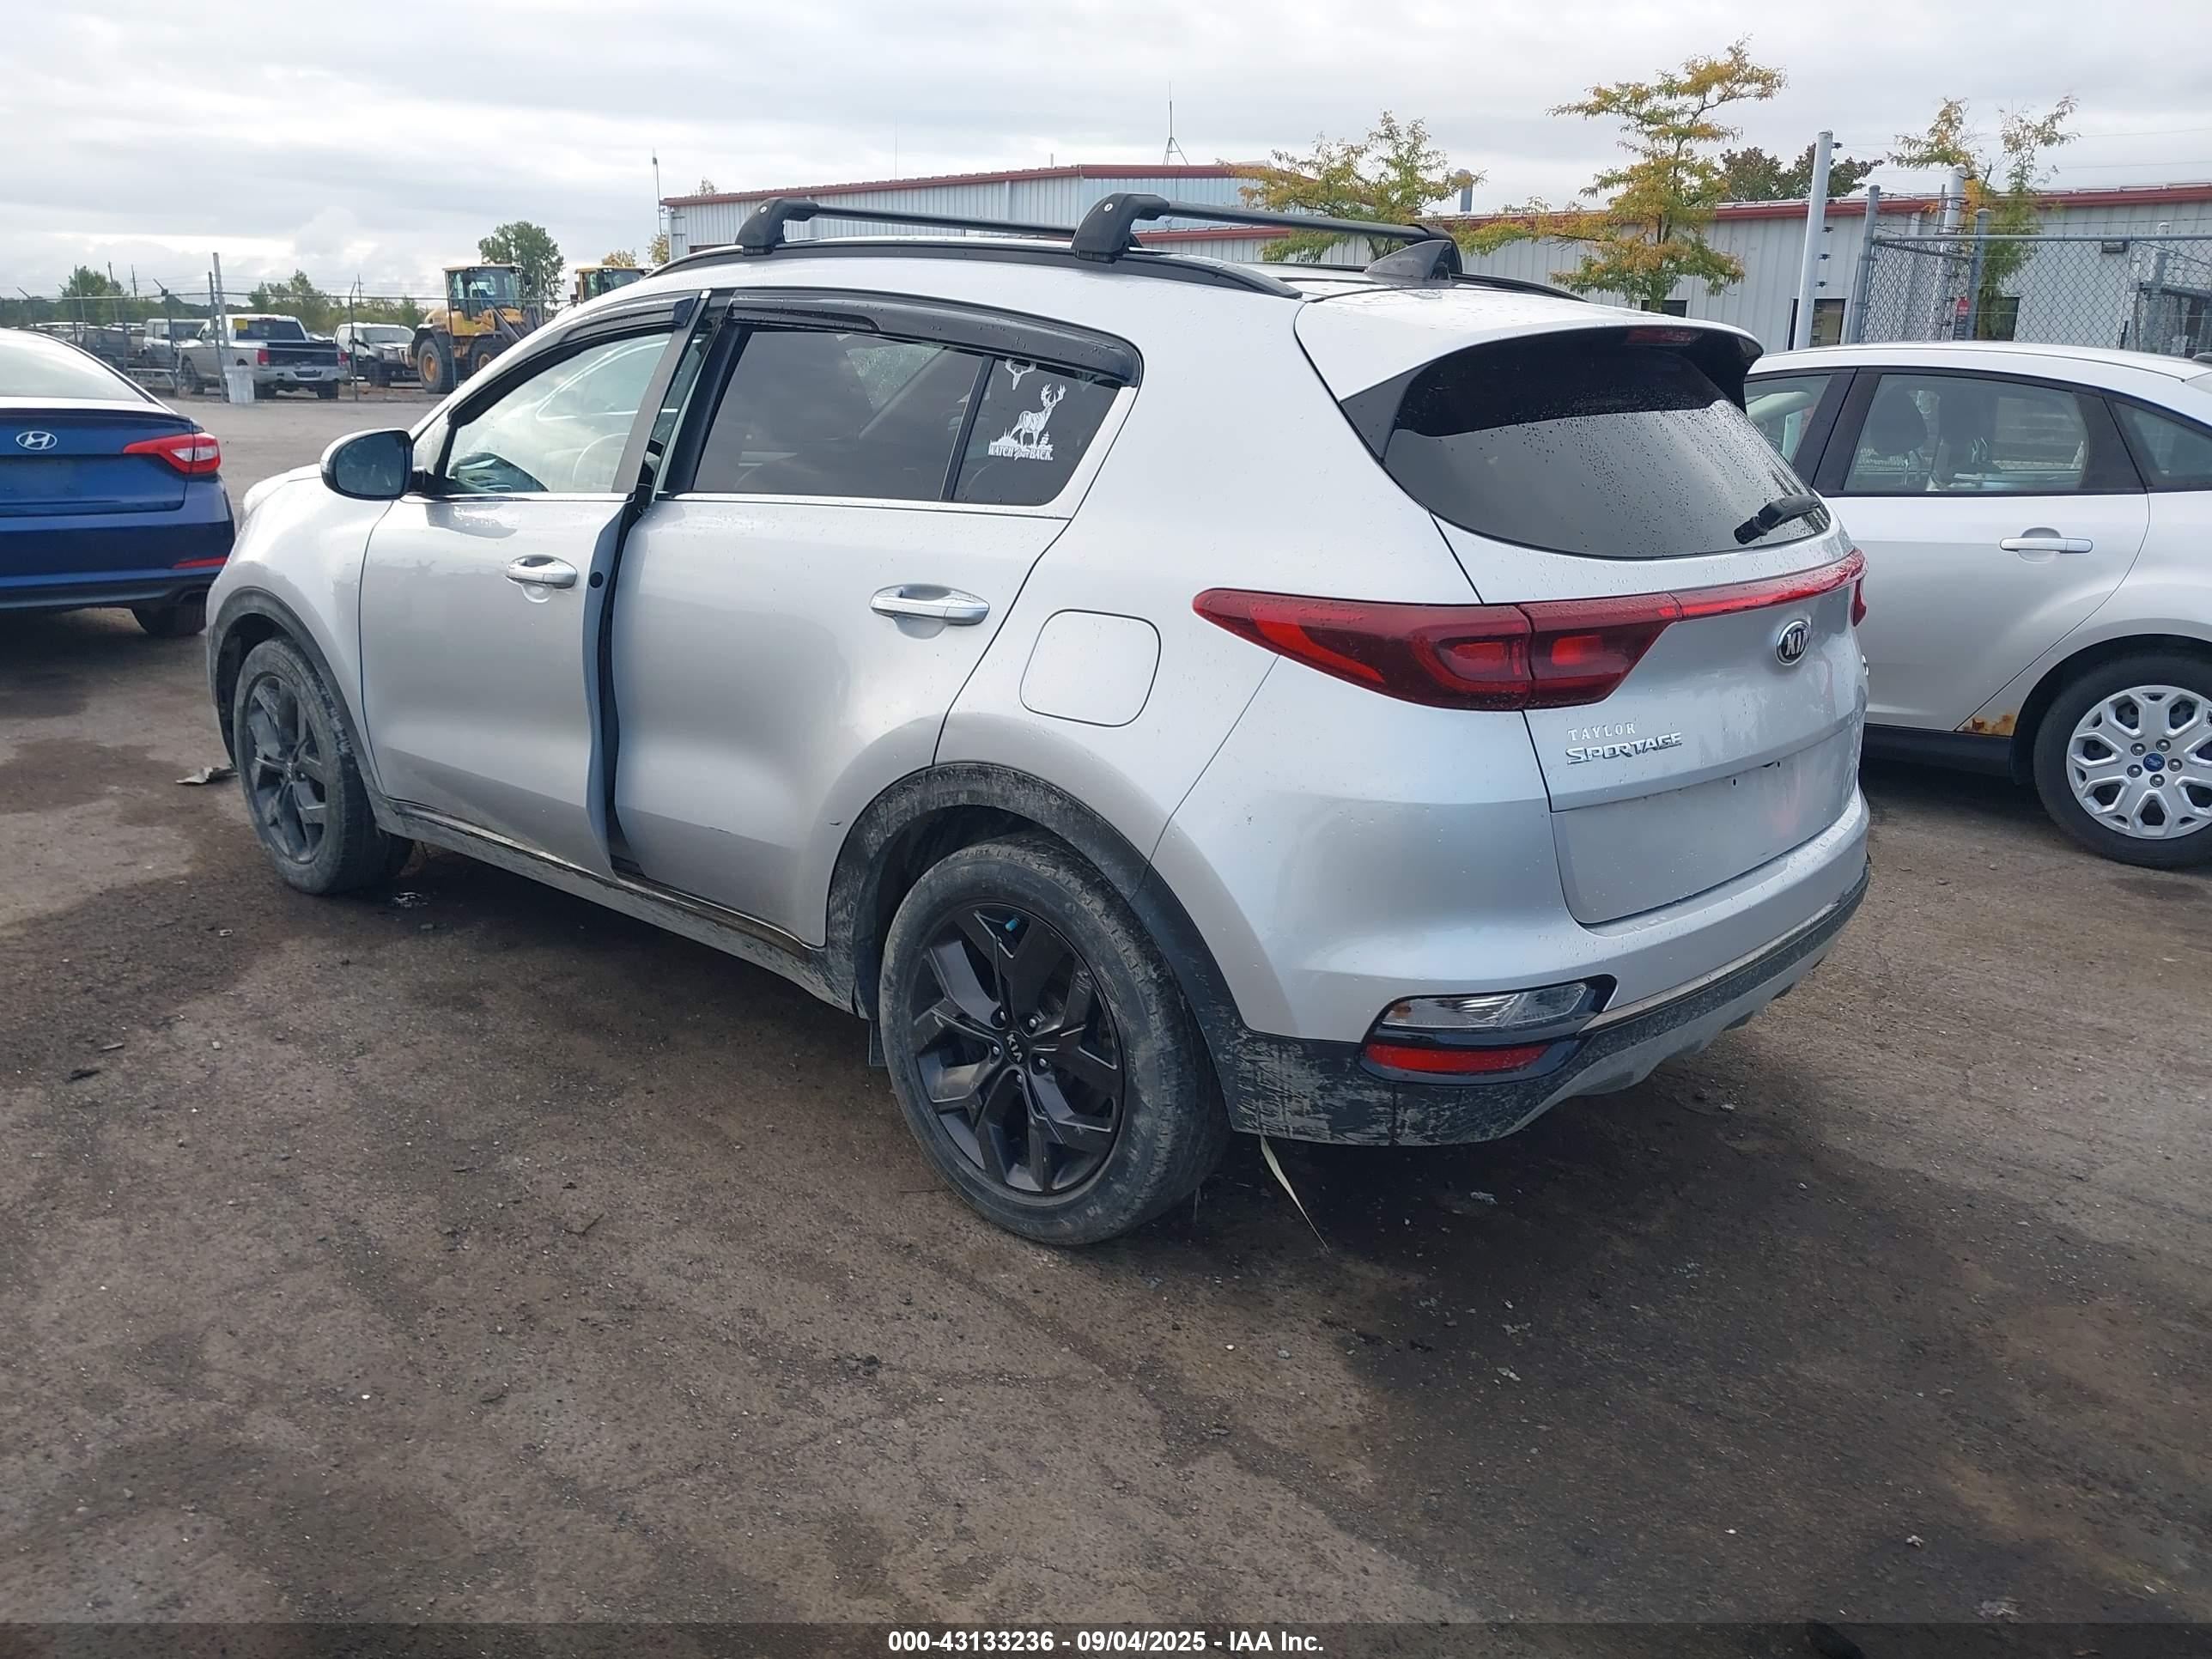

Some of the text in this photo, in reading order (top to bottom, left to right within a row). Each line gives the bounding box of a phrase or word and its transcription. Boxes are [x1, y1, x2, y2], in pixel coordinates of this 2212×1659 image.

[988, 446, 1013, 457] WATCH
[1567, 723, 1636, 741] TAYLOR
[1565, 732, 1683, 764] SPORTAGE
